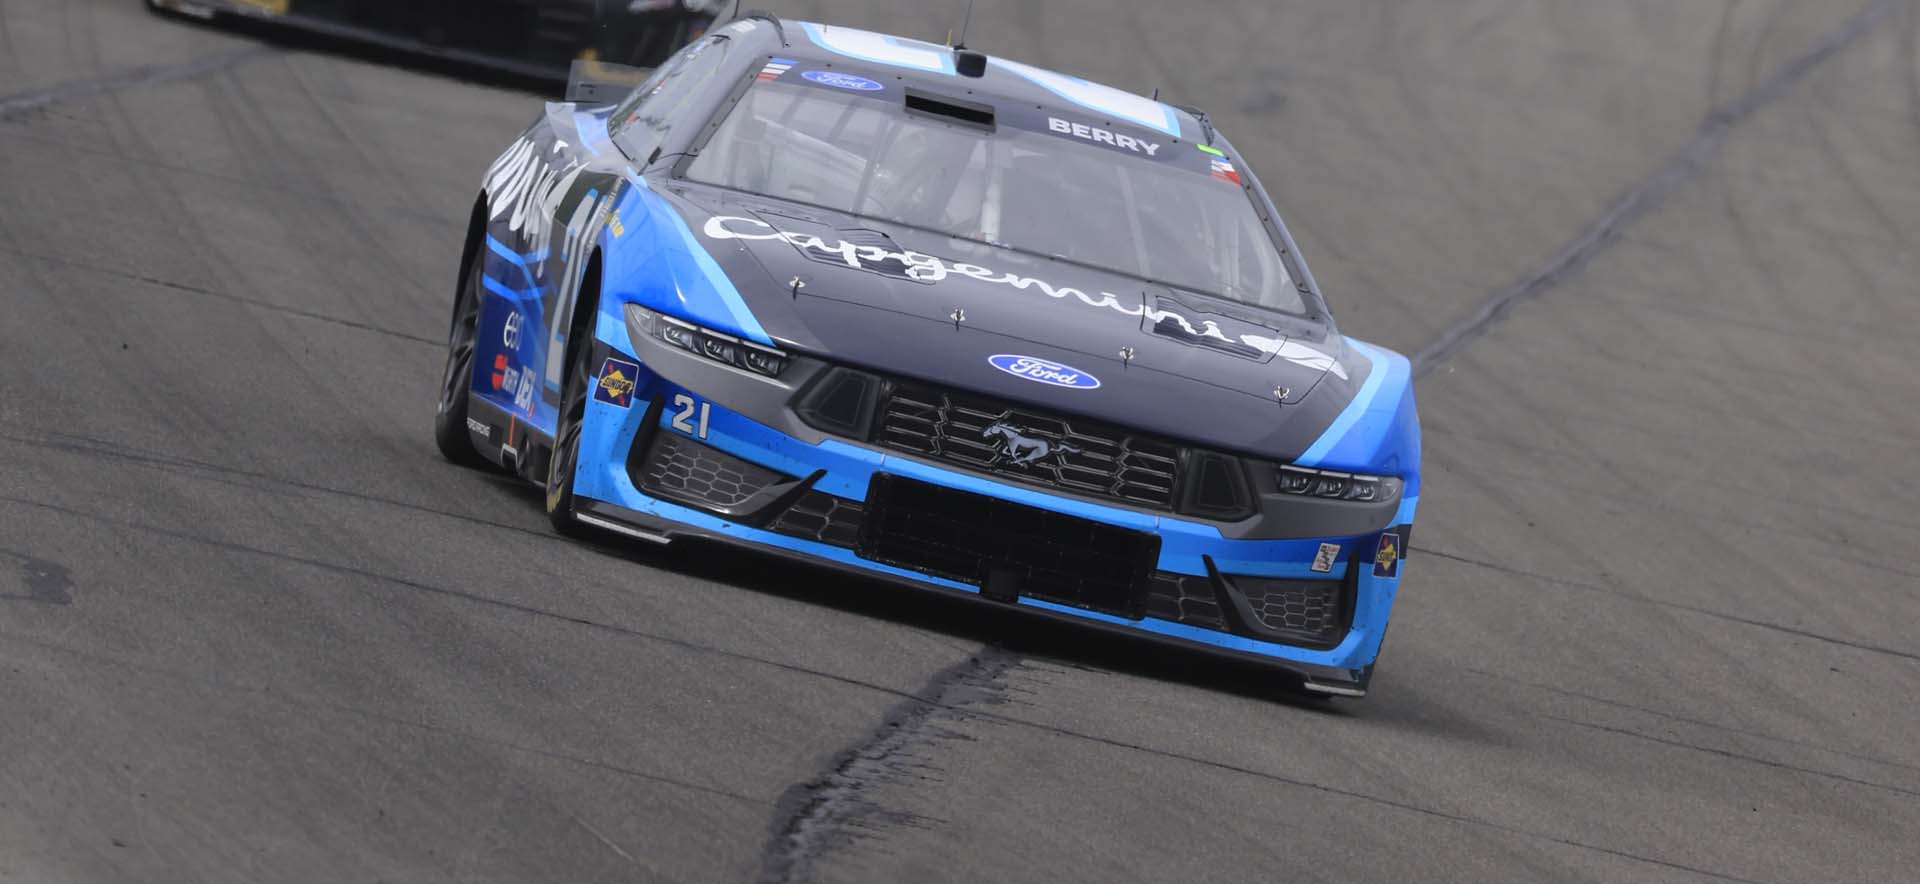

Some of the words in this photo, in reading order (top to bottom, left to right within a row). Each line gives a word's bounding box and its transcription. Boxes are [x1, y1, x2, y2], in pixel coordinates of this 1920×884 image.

[1048, 116, 1160, 156] BERRY
[704, 215, 1236, 343] Capgemini
[1009, 358, 1079, 385] Ford
[672, 393, 711, 440] 21
